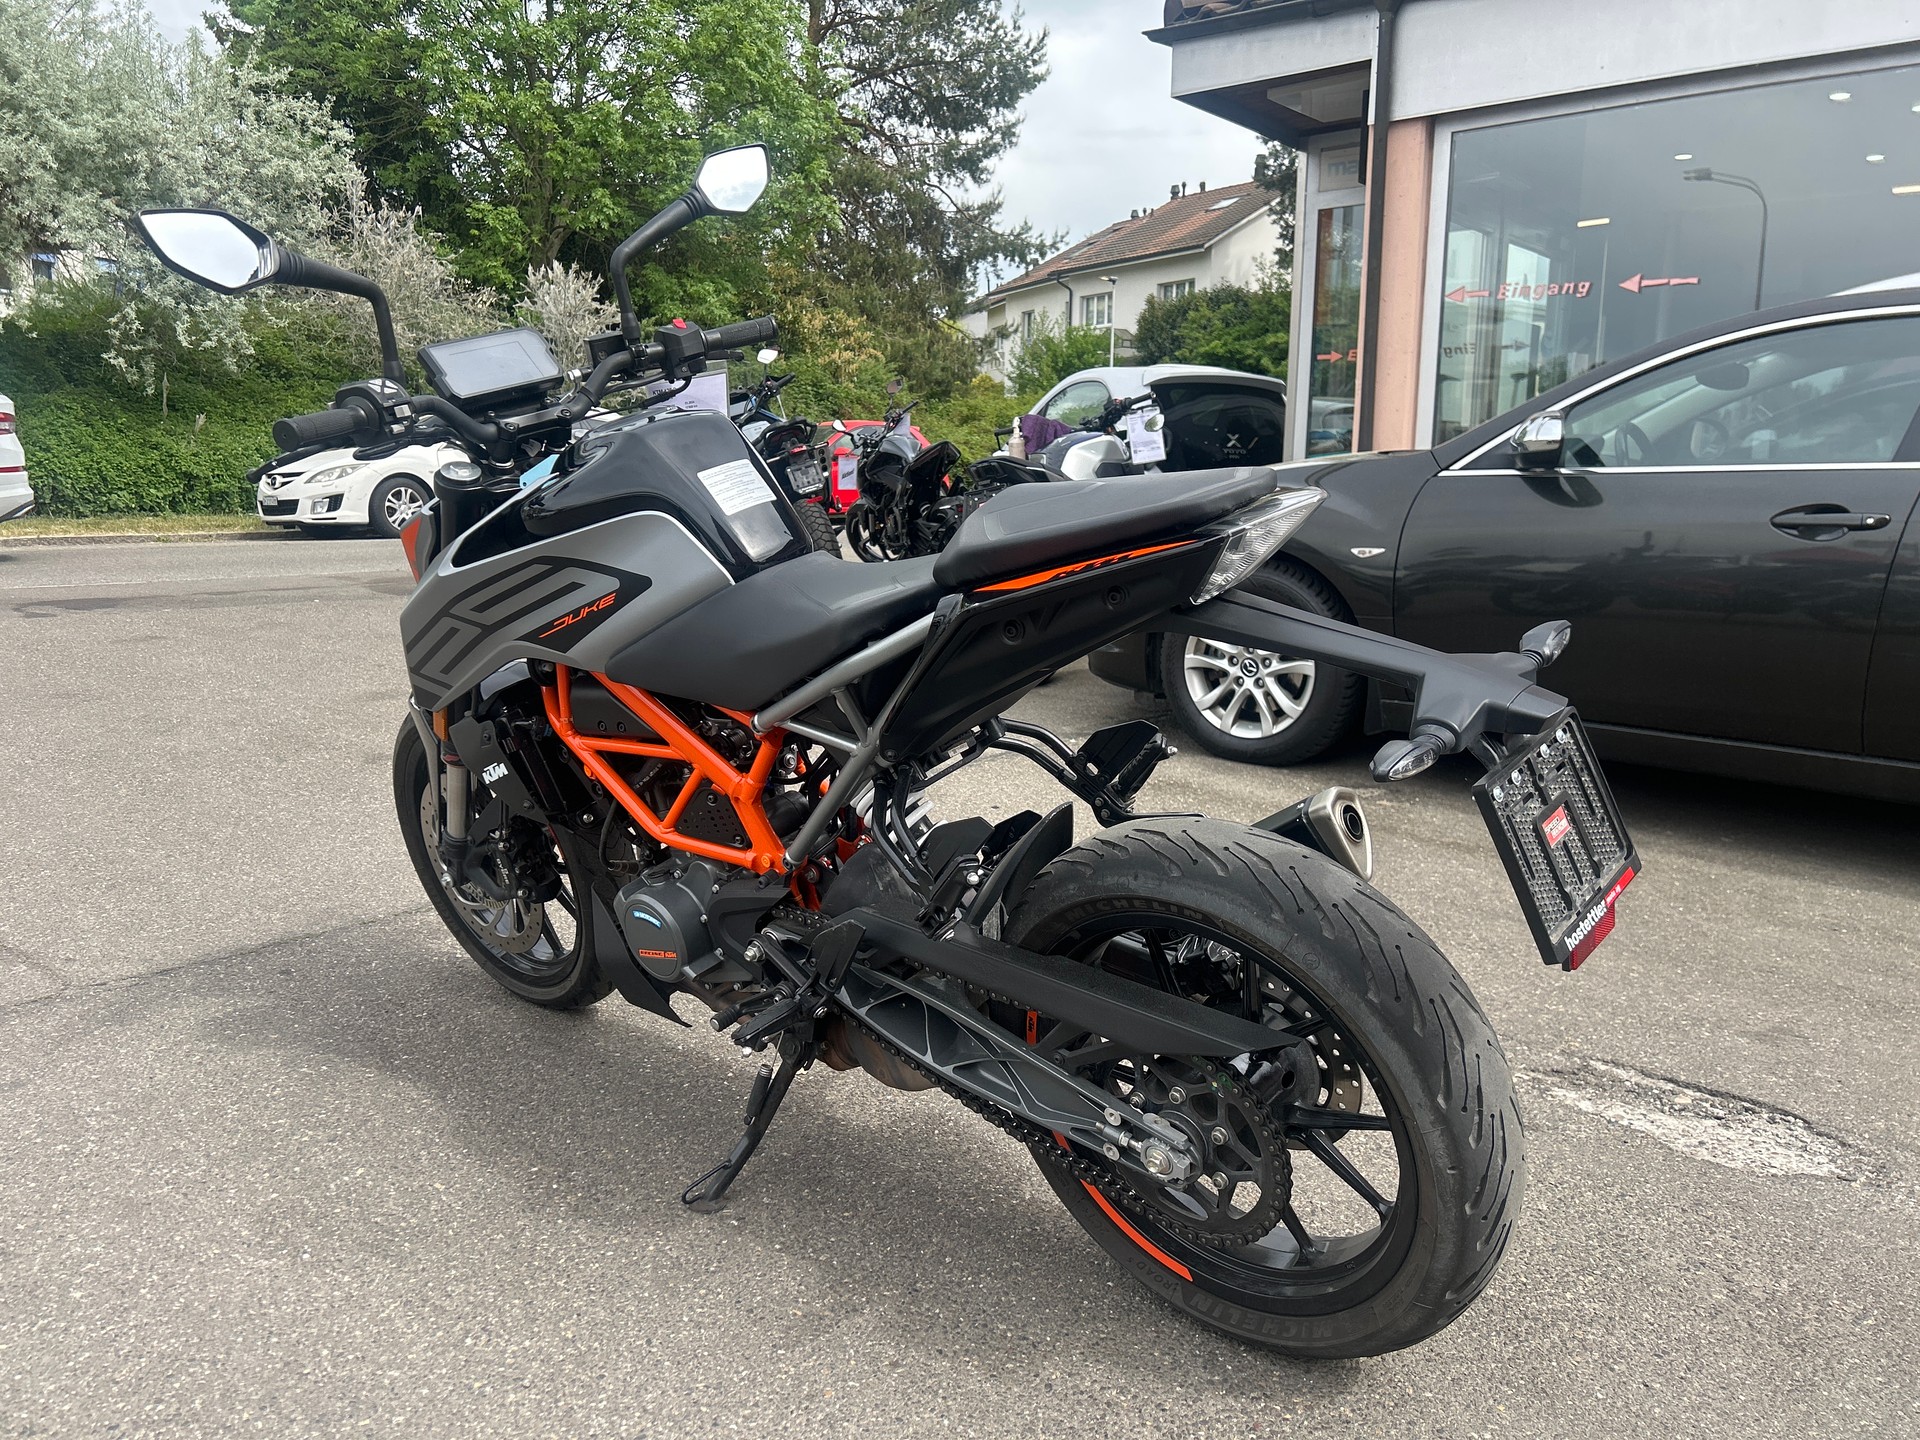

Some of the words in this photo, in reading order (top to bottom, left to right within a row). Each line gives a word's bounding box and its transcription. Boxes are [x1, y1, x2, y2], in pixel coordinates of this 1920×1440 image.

[1496, 280, 1592, 301] Eingang
[538, 592, 616, 638] DUKE
[482, 762, 509, 785] KTM
[1065, 898, 1203, 921] MICHELIN
[1564, 900, 1606, 951] hostettler
[1137, 1260, 1174, 1290] ROAD
[1190, 1291, 1333, 1339] MICHELIN
